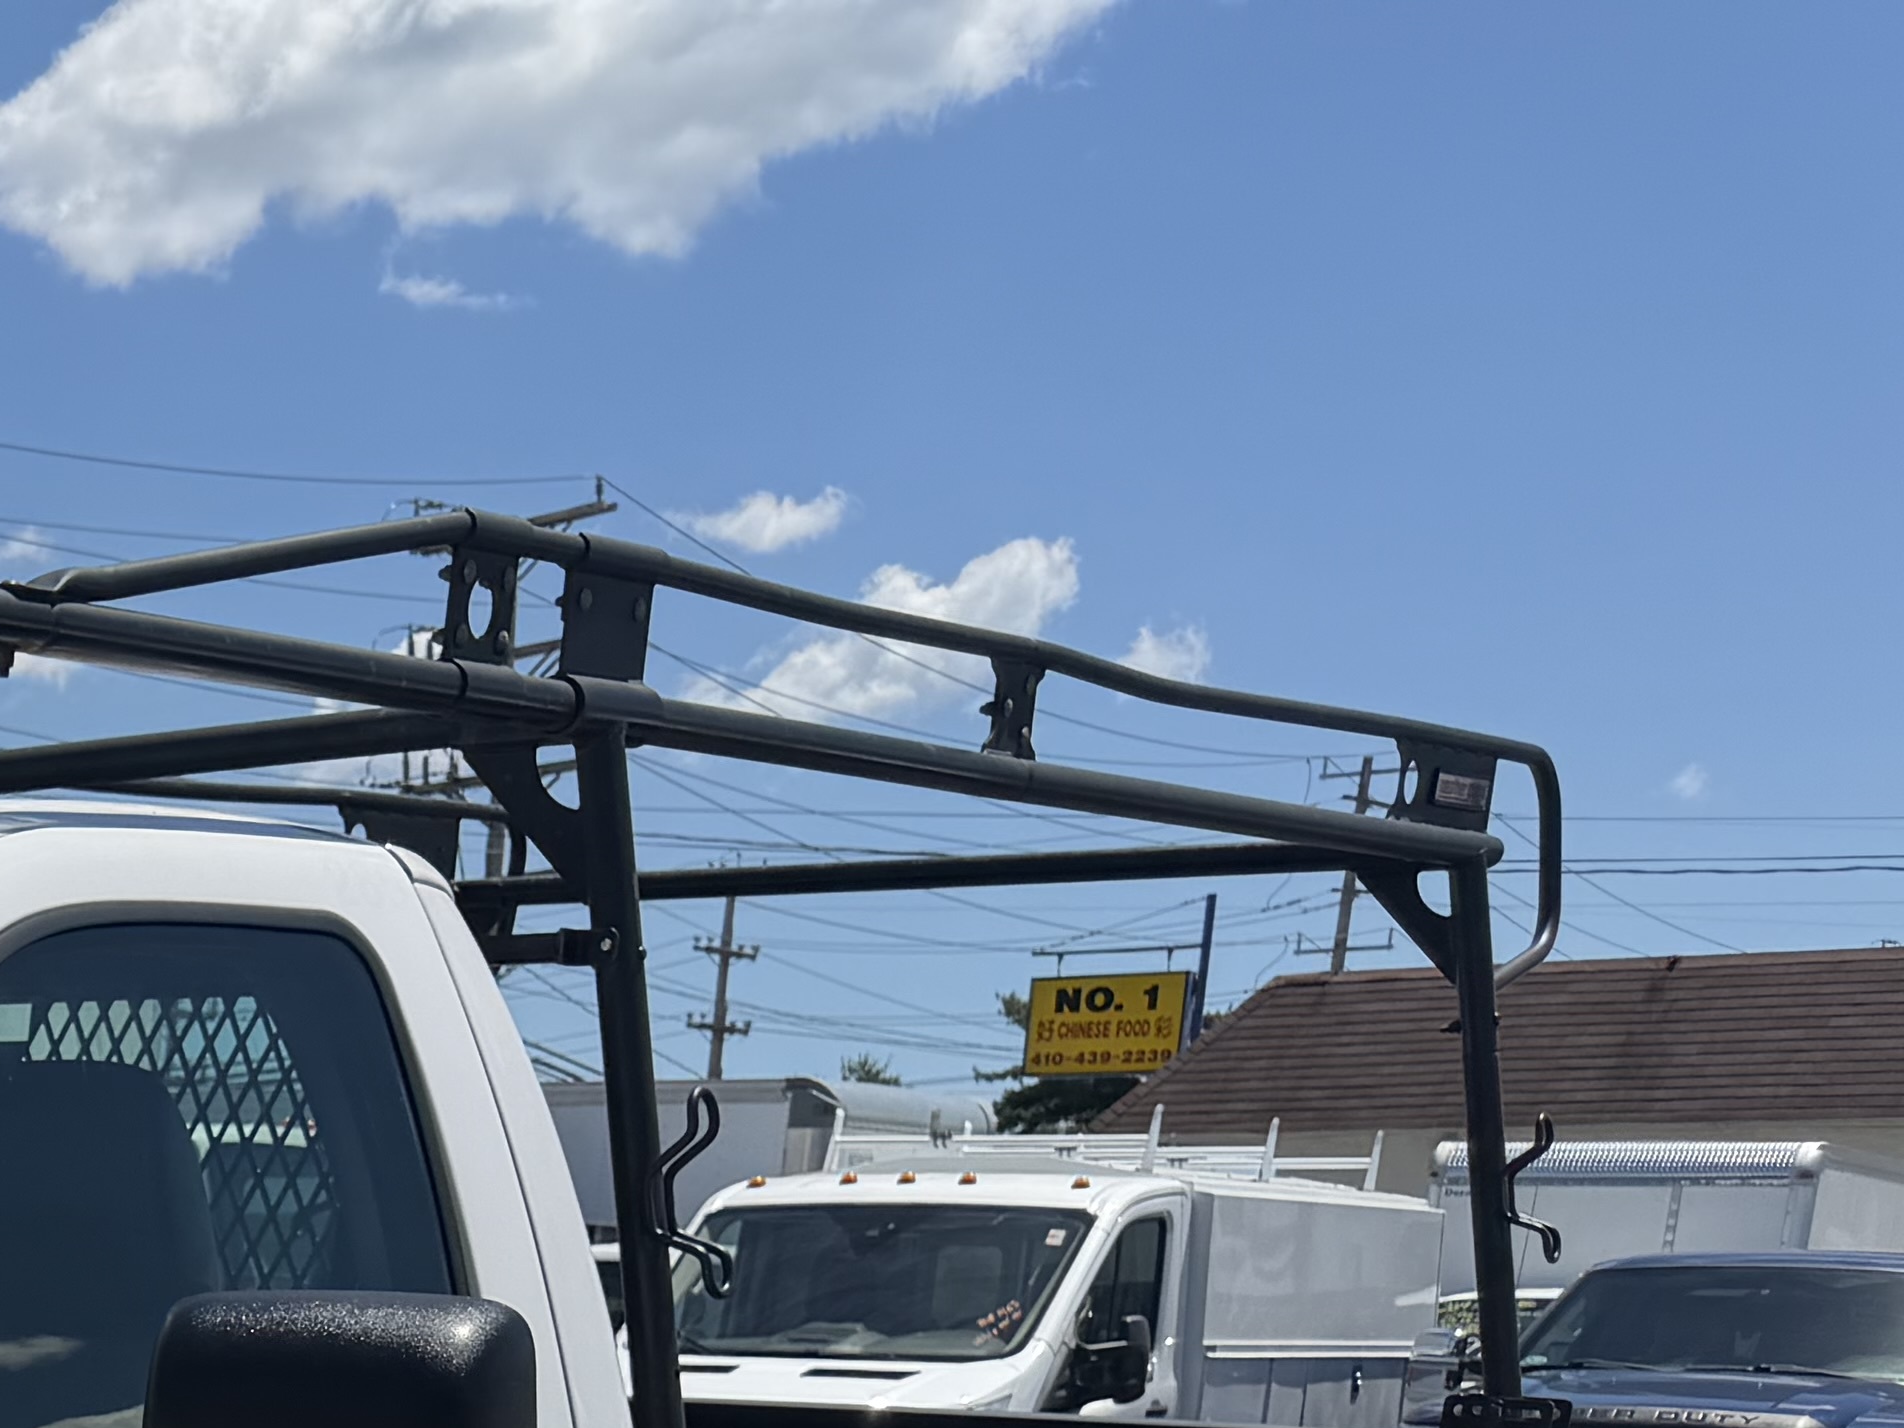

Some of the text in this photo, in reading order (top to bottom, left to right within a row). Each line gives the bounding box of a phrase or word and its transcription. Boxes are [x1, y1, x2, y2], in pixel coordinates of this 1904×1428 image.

[1054, 983, 1160, 1014] NO. 1
[1057, 1018, 1151, 1041] CHINESE FOOD
[1652, 1409, 1760, 1426] DUTY
